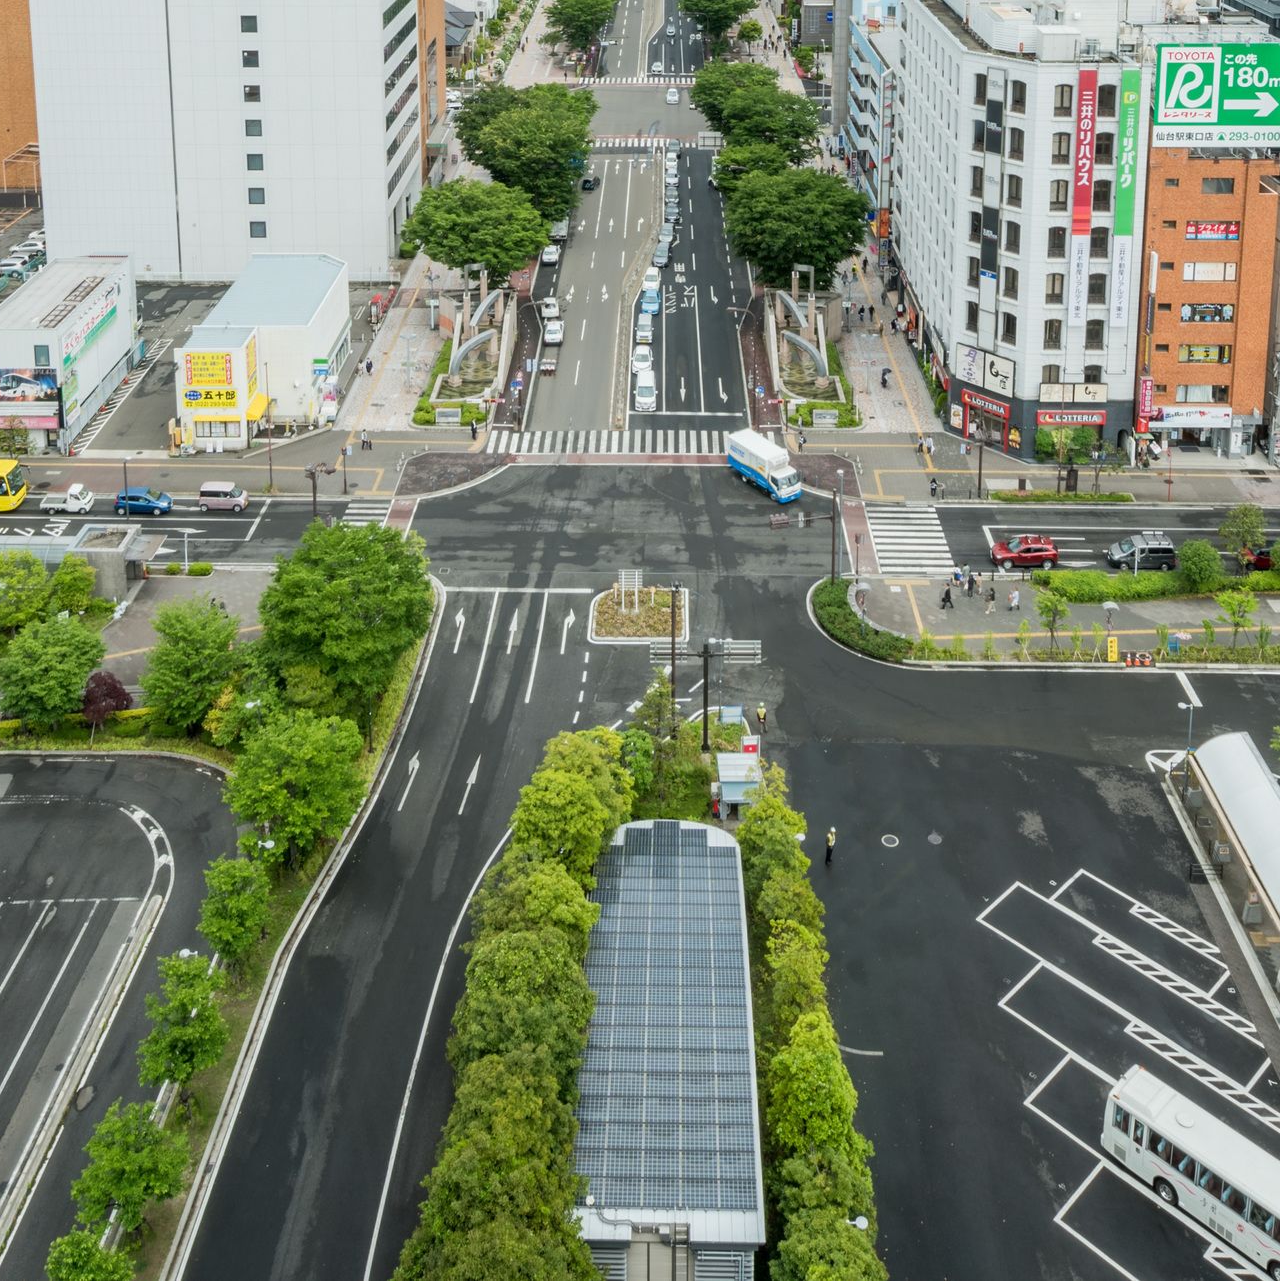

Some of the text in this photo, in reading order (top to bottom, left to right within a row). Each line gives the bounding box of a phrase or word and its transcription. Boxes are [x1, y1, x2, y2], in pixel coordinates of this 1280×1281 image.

[1167, 51, 1215, 61] TOYOTA
[1224, 54, 1258, 65] この先
[1077, 91, 1093, 186] 三井のリハウス
[1155, 131, 1280, 141] 仙台駅東口店 293-0100
[1120, 108, 1136, 188] 三井のリパーク
[203, 391, 236, 400] 五十郎
[972, 397, 1005, 414] LOTTERIA
[1055, 414, 1098, 422] LOTTERIA
